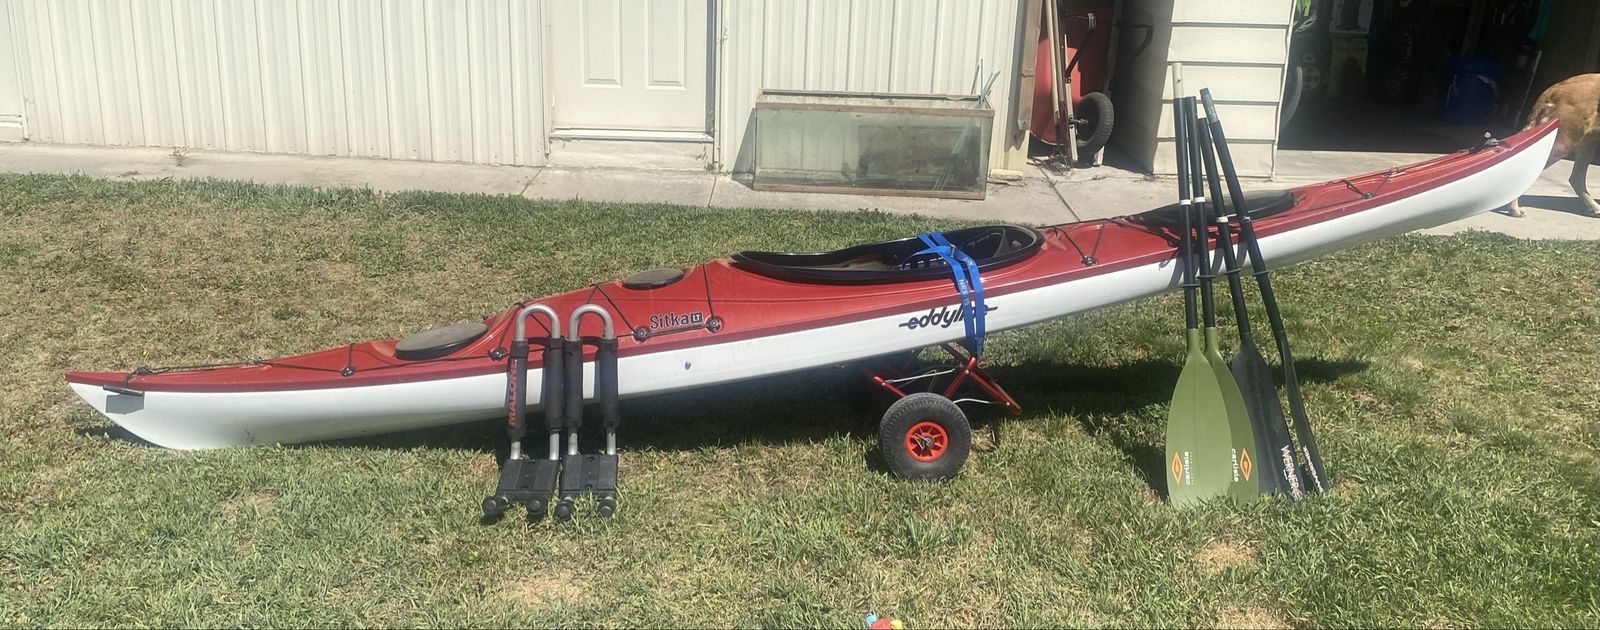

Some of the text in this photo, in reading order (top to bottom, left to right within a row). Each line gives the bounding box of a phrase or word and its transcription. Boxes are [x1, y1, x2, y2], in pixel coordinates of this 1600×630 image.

[649, 312, 689, 329] Sitka
[1183, 451, 1191, 486] carlisle
[1231, 448, 1240, 482] carlisle
[1280, 444, 1300, 490] WERNER
